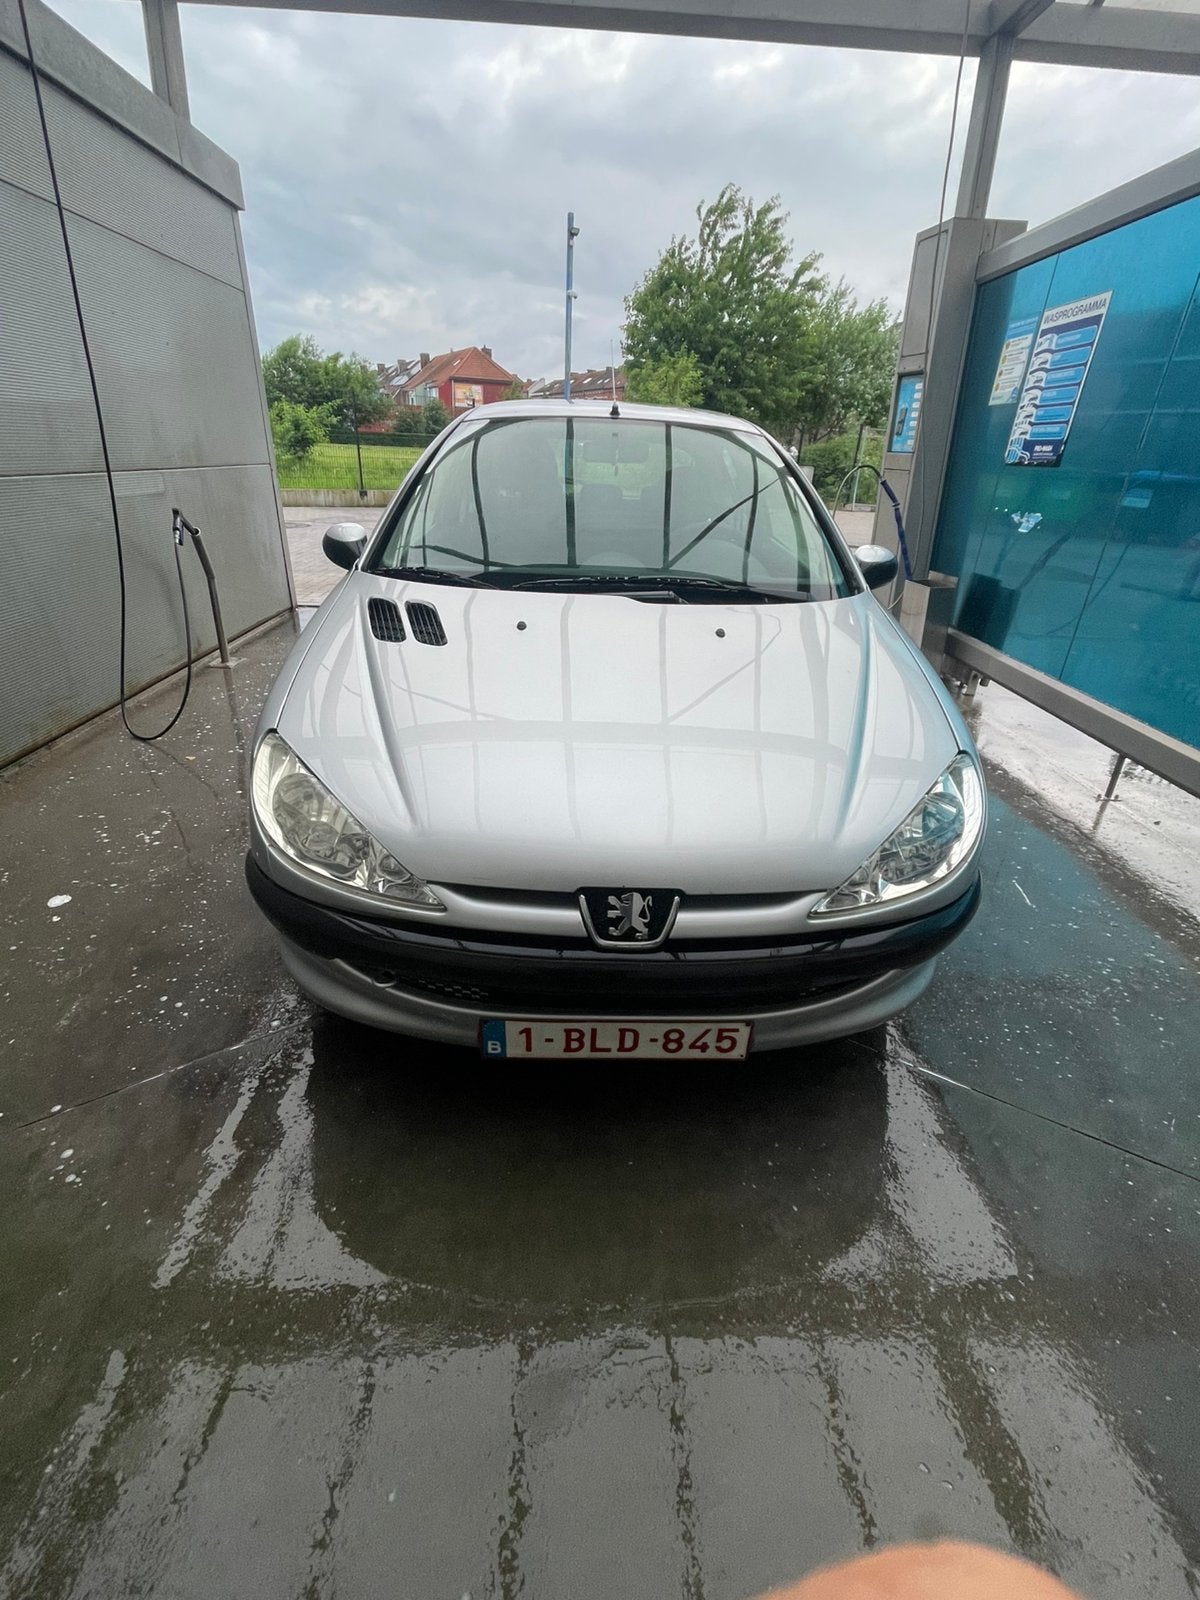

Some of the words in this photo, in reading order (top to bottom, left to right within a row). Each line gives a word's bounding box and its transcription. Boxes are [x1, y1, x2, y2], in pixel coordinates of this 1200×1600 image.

[1043, 298, 1107, 325] WASPROGRAMMA
[487, 1041, 501, 1054] B
[518, 1027, 740, 1054] 1-BLD-845
